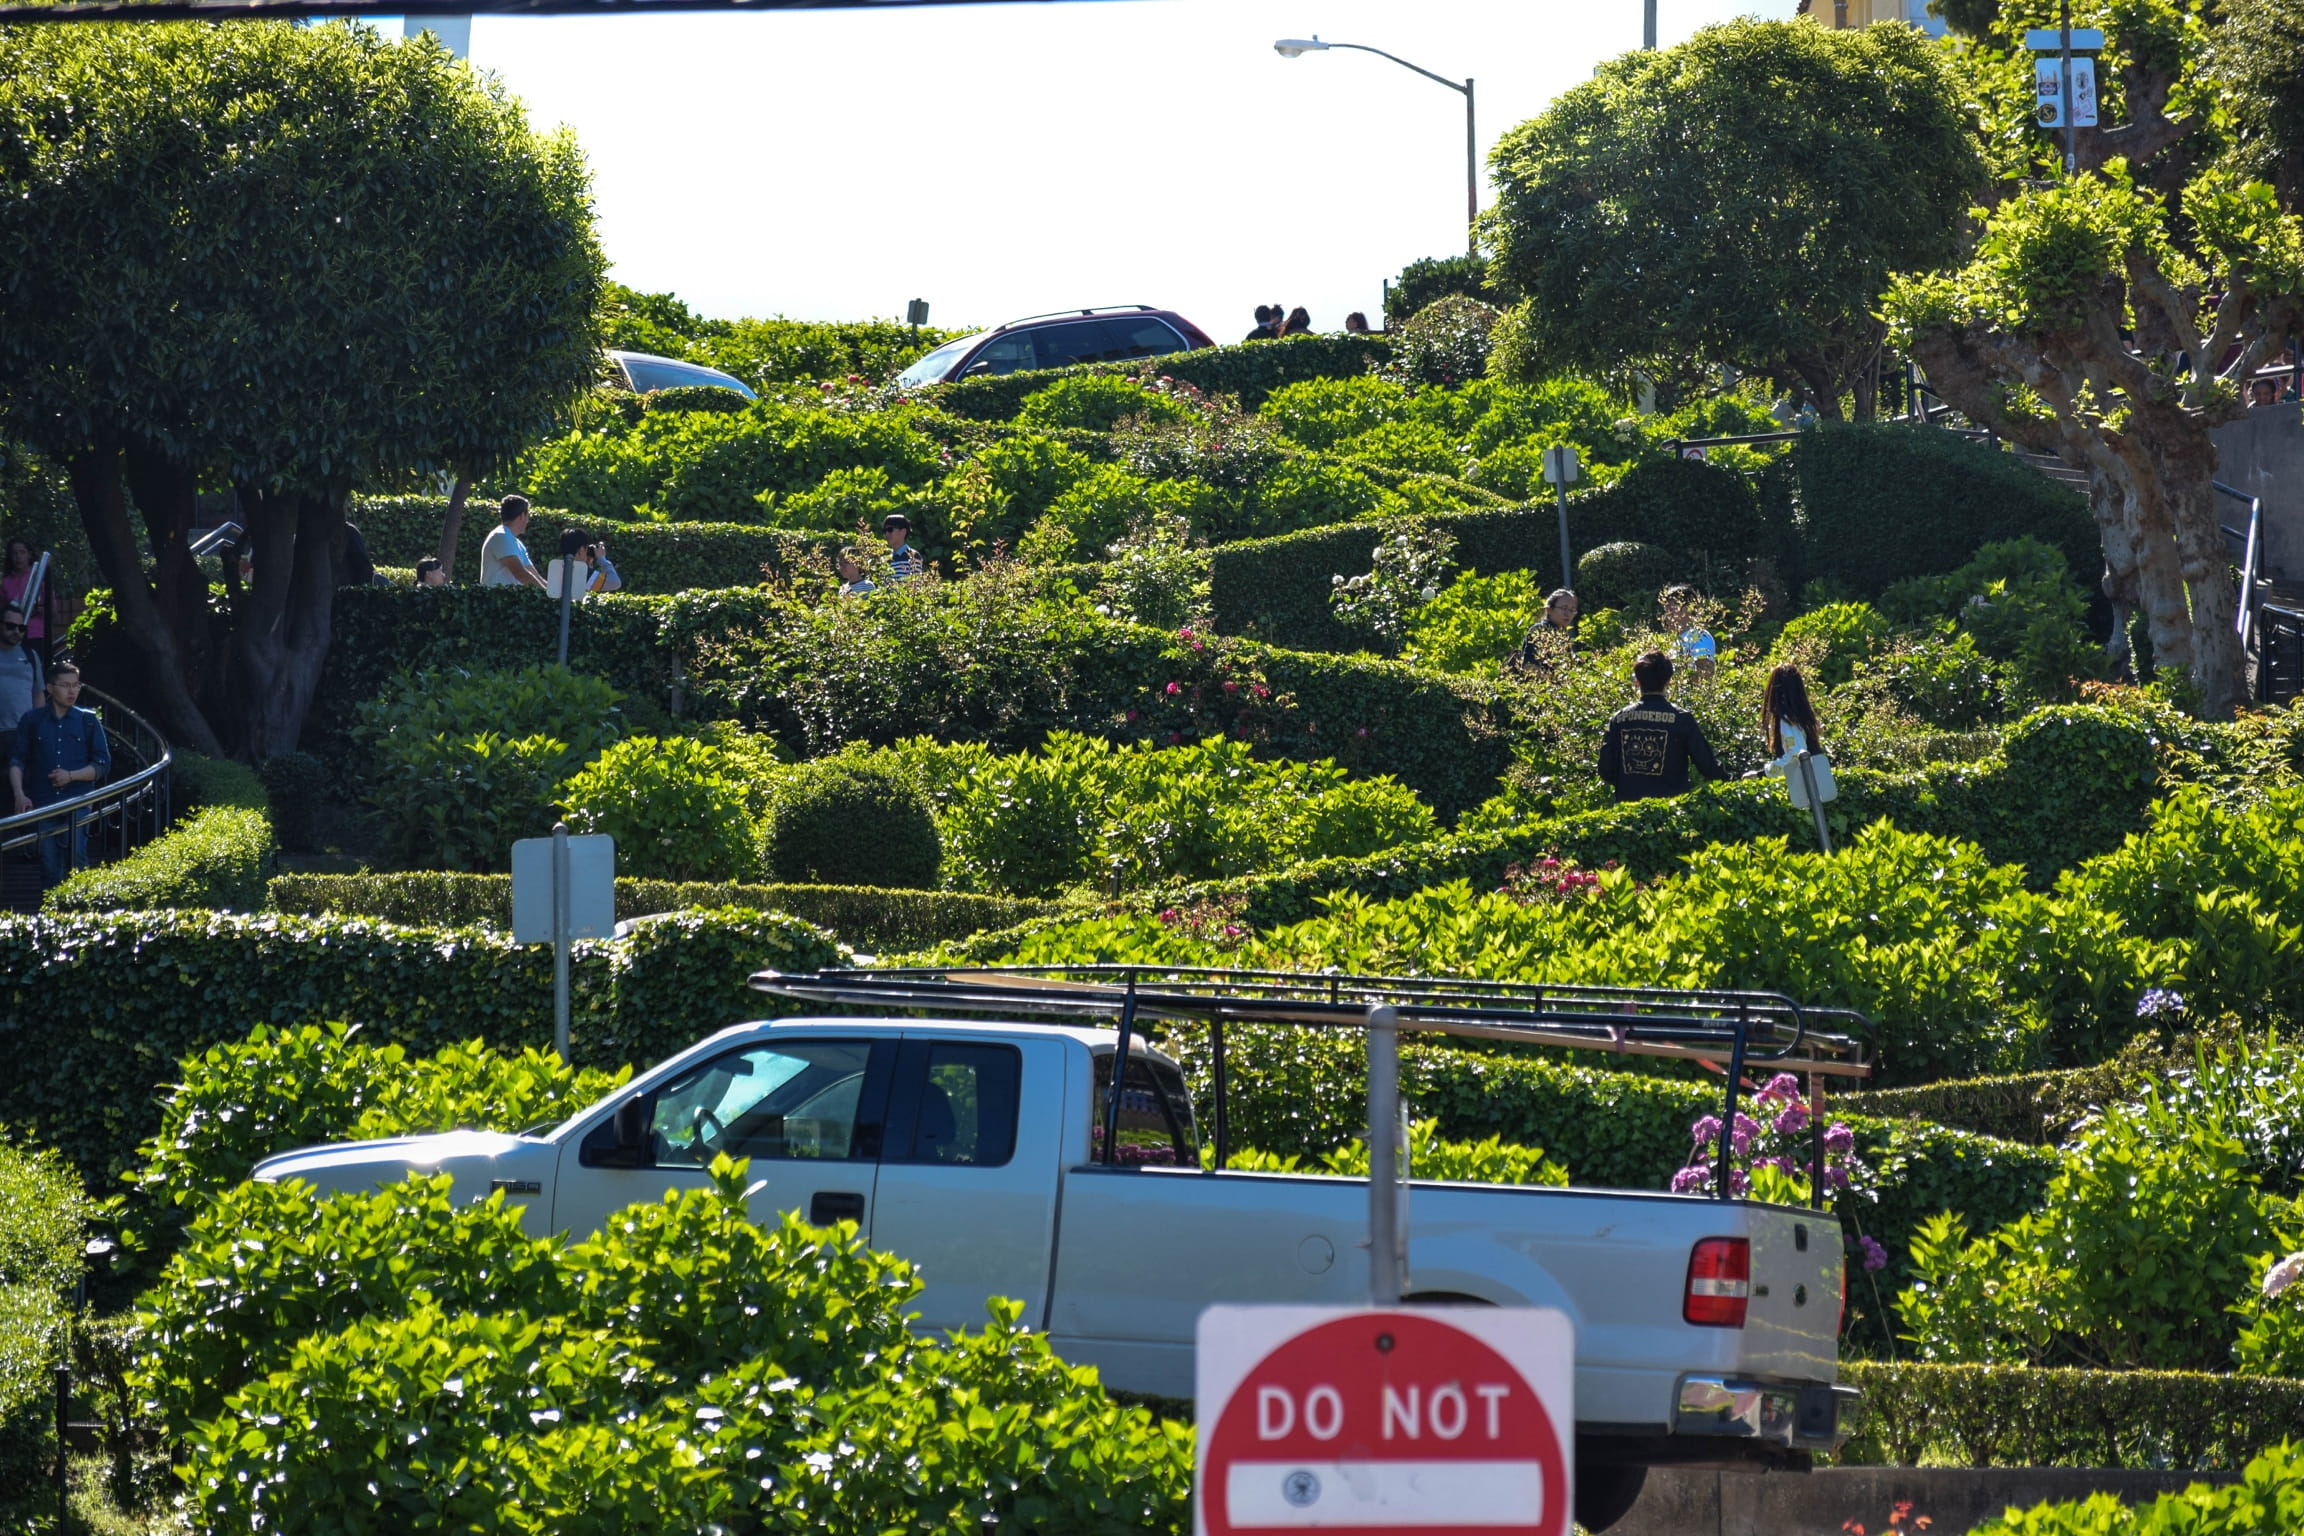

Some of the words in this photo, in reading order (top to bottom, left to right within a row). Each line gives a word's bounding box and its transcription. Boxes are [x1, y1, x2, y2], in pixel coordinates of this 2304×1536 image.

[1616, 710, 1676, 723] SPONGEBOB
[1257, 1385, 1343, 1441] DO
[1381, 1385, 1509, 1441] NOT
